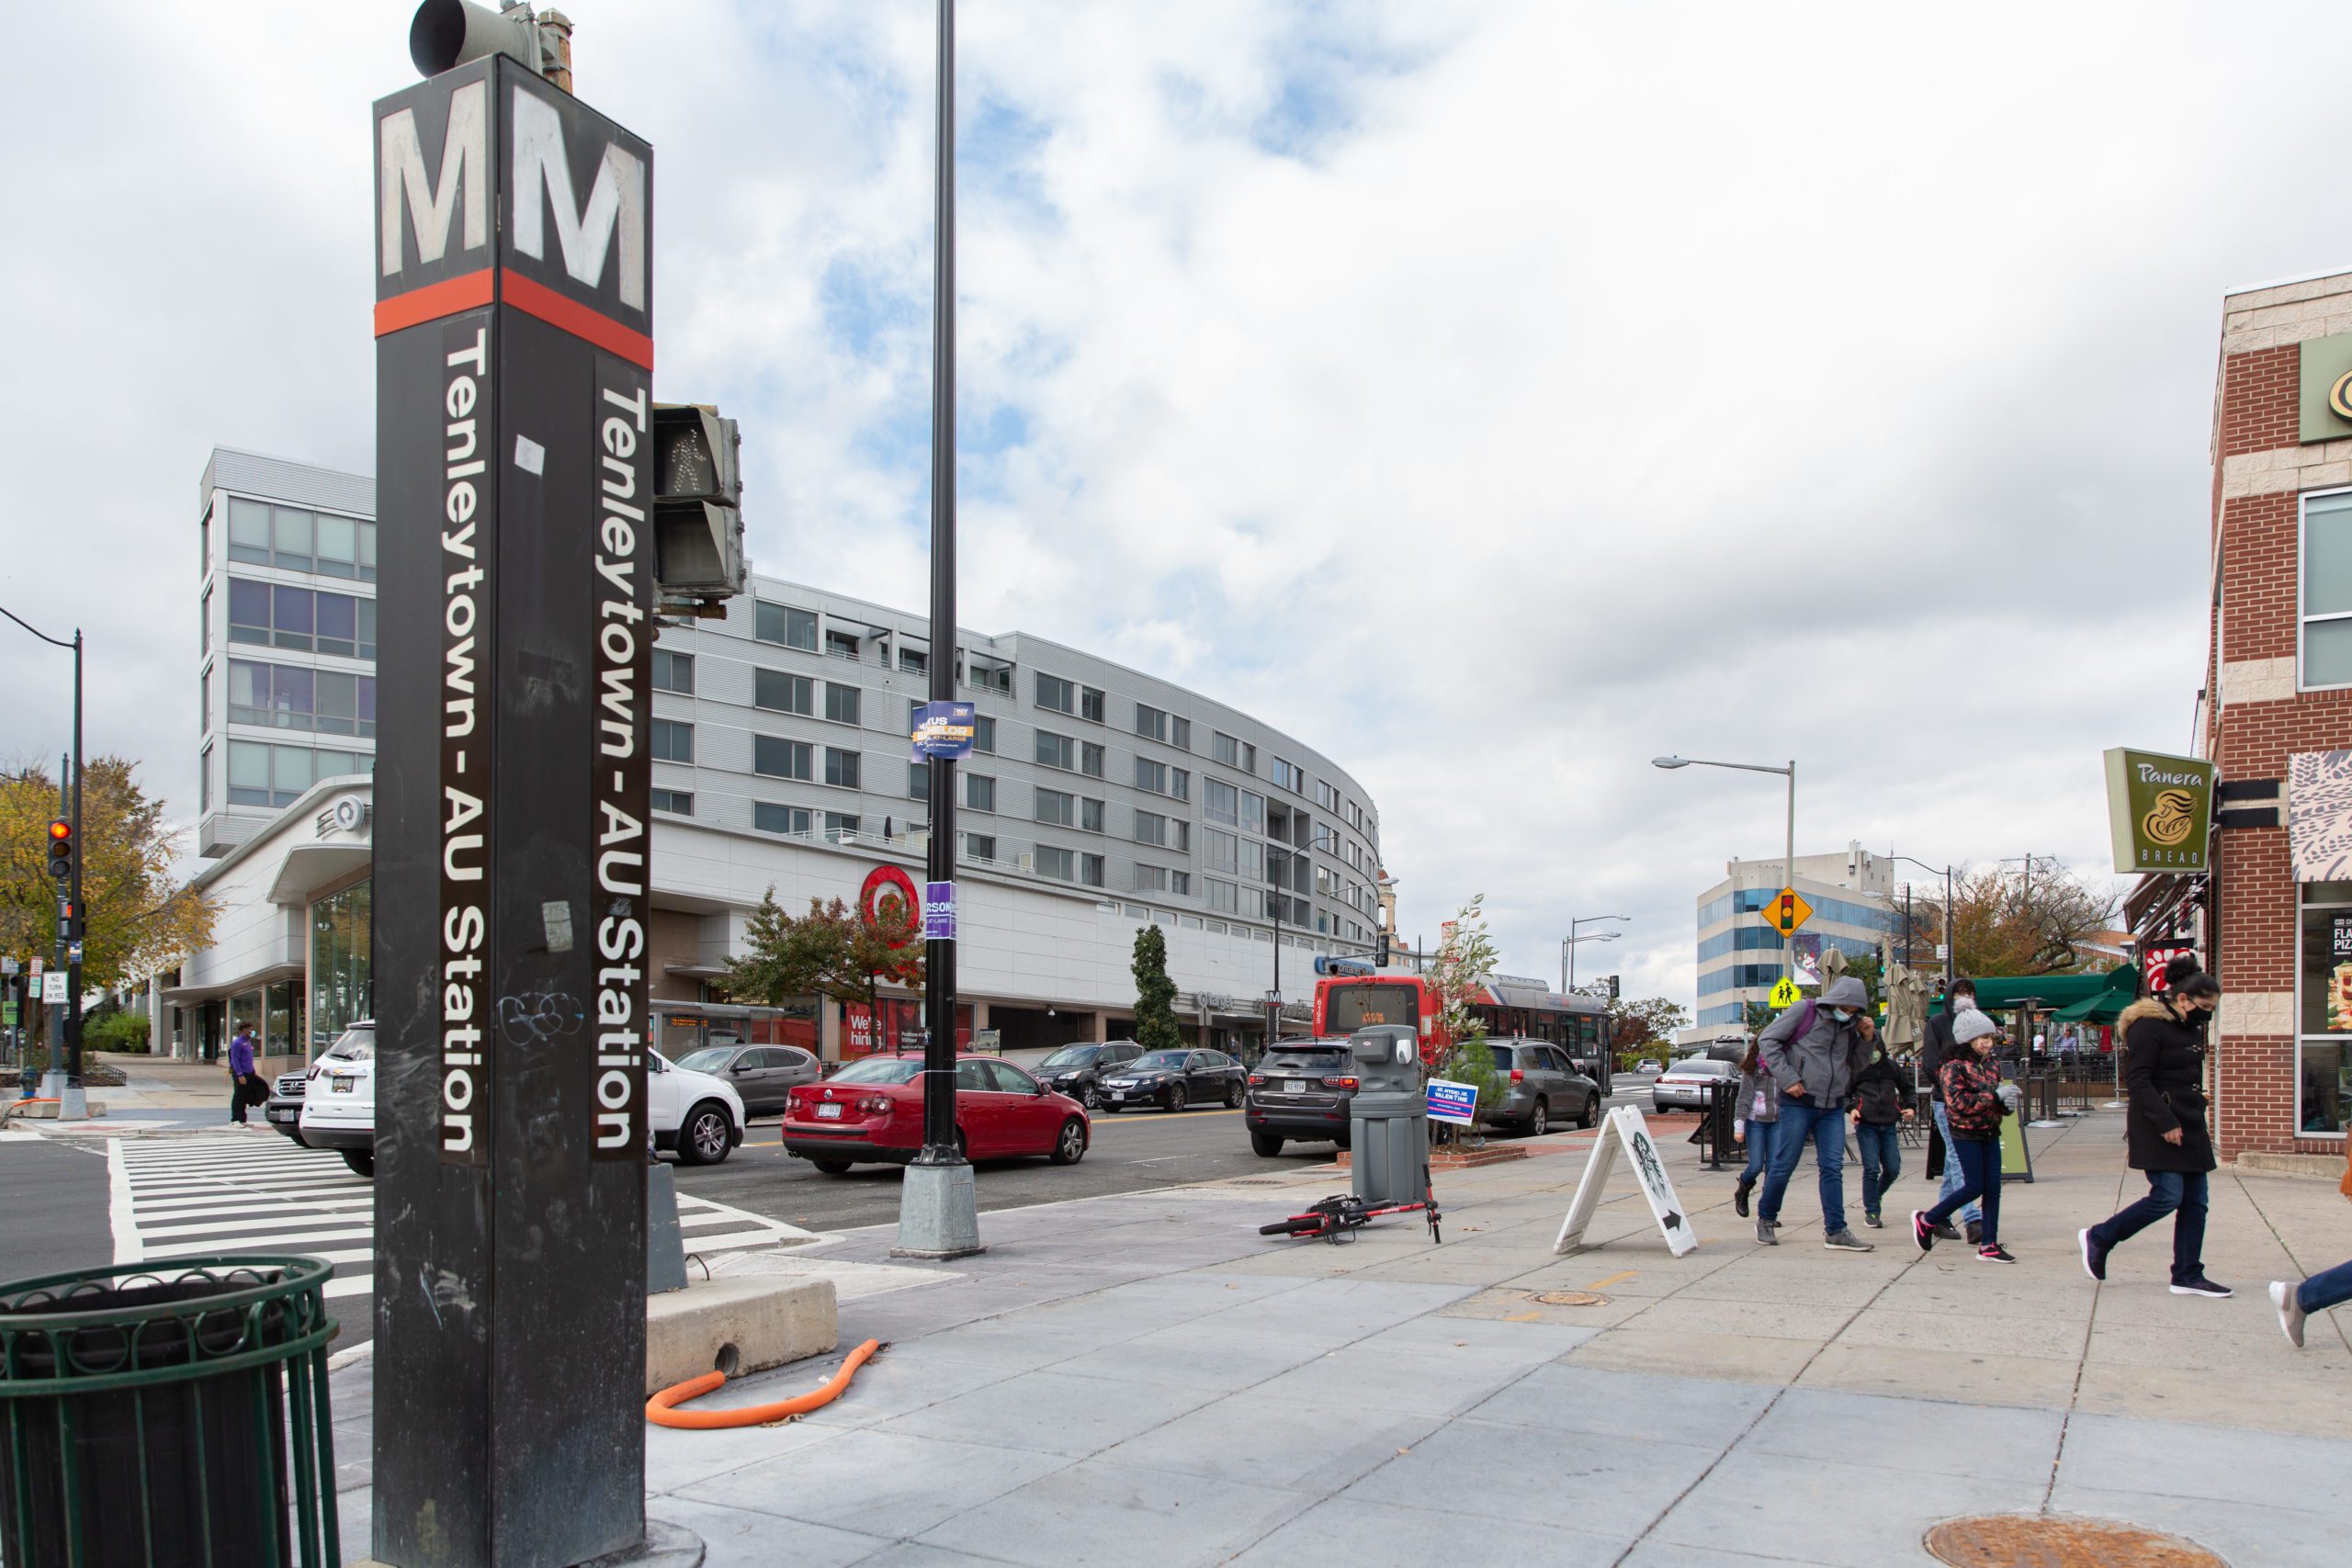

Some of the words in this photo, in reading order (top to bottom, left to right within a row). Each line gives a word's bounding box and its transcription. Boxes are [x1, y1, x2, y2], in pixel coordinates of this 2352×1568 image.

[380, 79, 486, 276] M
[514, 85, 645, 312] M
[2137, 763, 2202, 787] Panera
[2143, 849, 2198, 864] BREAD
[2335, 939, 2352, 950] PIZ
[1269, 992, 1280, 1003] M
[444, 905, 485, 1152] Station
[597, 916, 644, 1148] Station
[851, 1015, 881, 1030] We'e
[1435, 1092, 1468, 1102] VALENTINE
